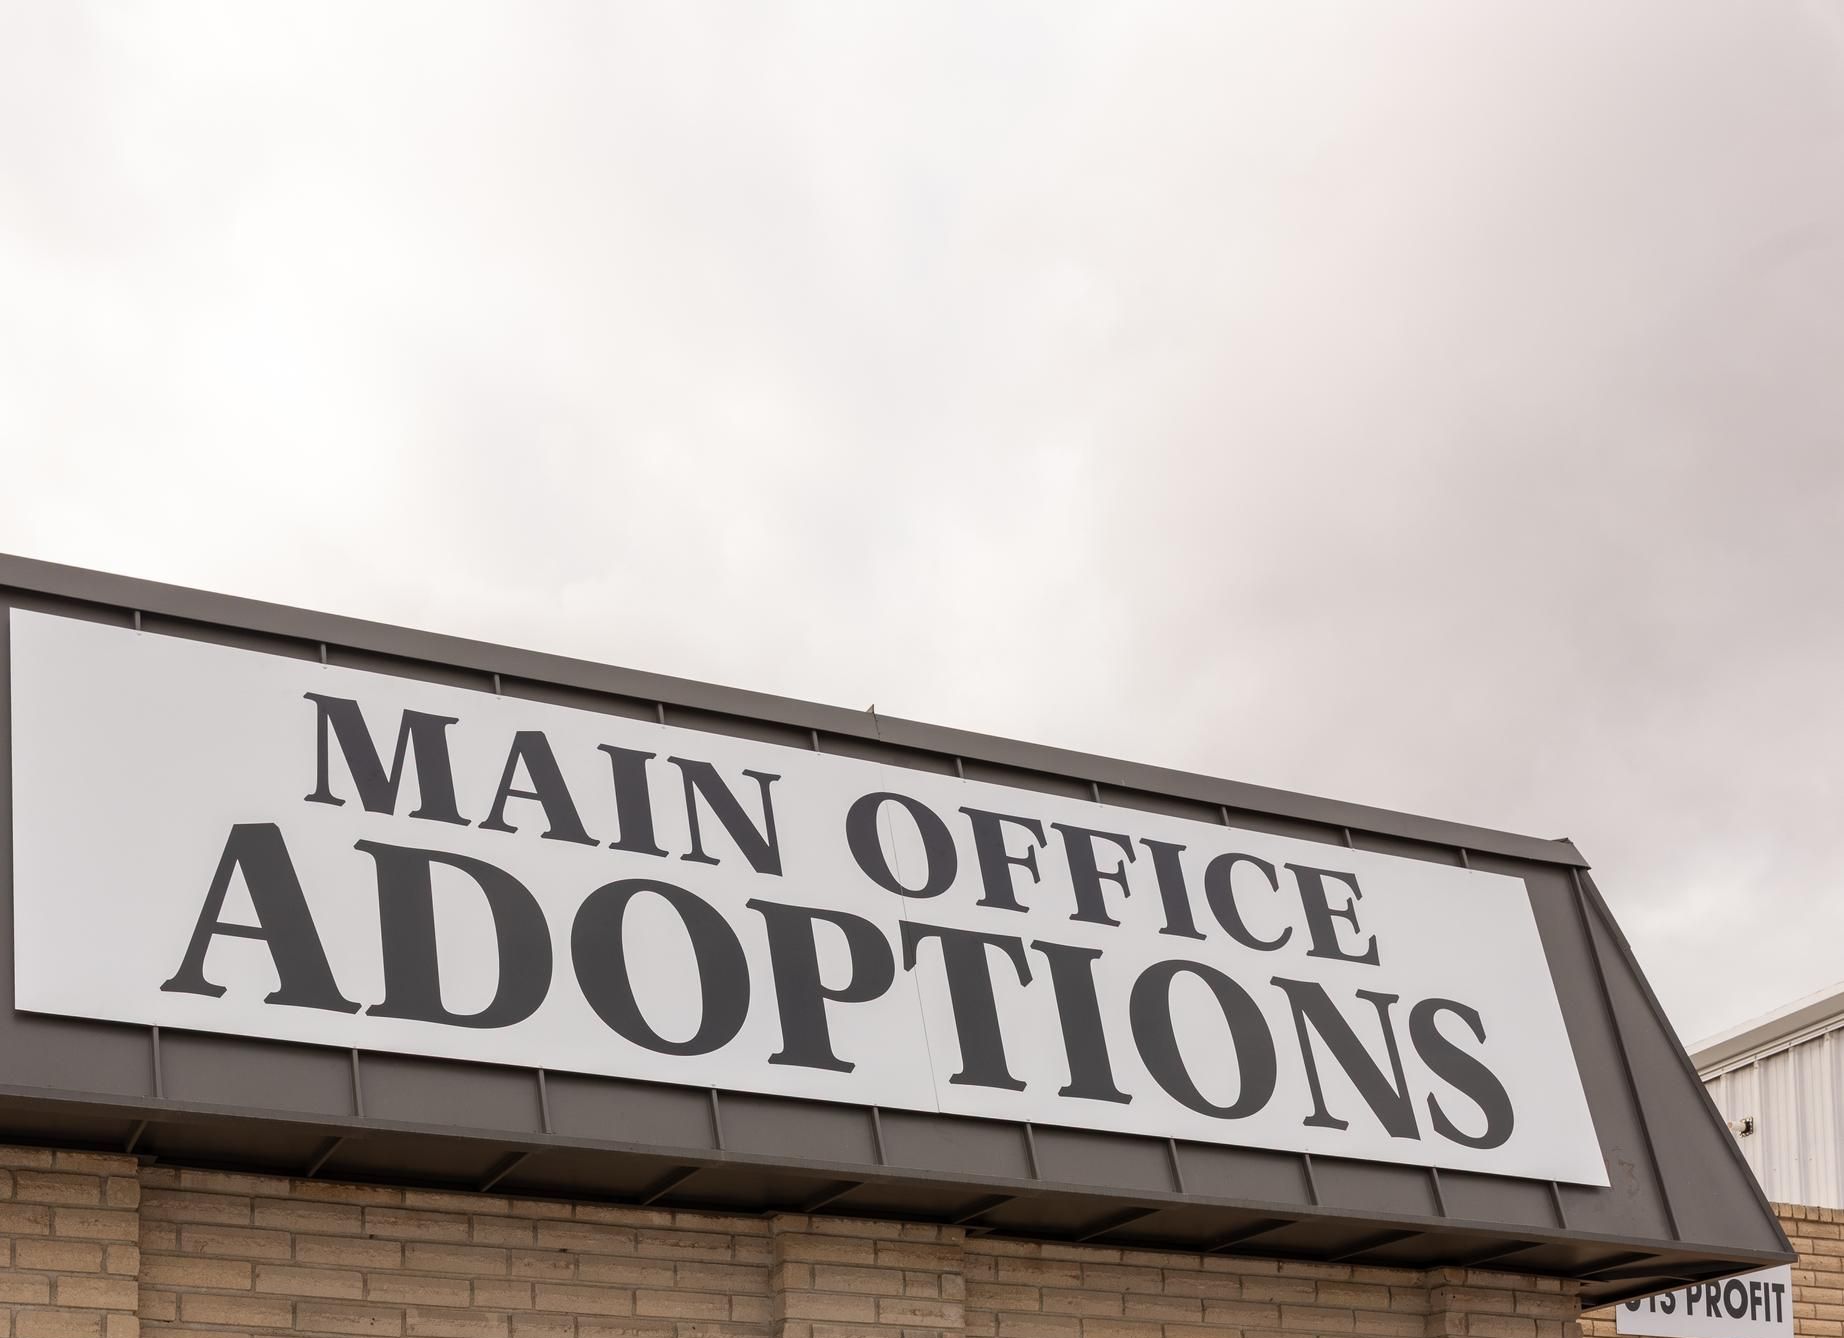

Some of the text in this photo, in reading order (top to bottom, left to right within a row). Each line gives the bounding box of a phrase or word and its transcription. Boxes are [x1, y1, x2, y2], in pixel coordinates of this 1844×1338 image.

[302, 691, 1381, 967] MAIN OFFICE
[159, 822, 1514, 1150] ADOPTIONS
[1686, 1279, 1785, 1322] PROFIT
